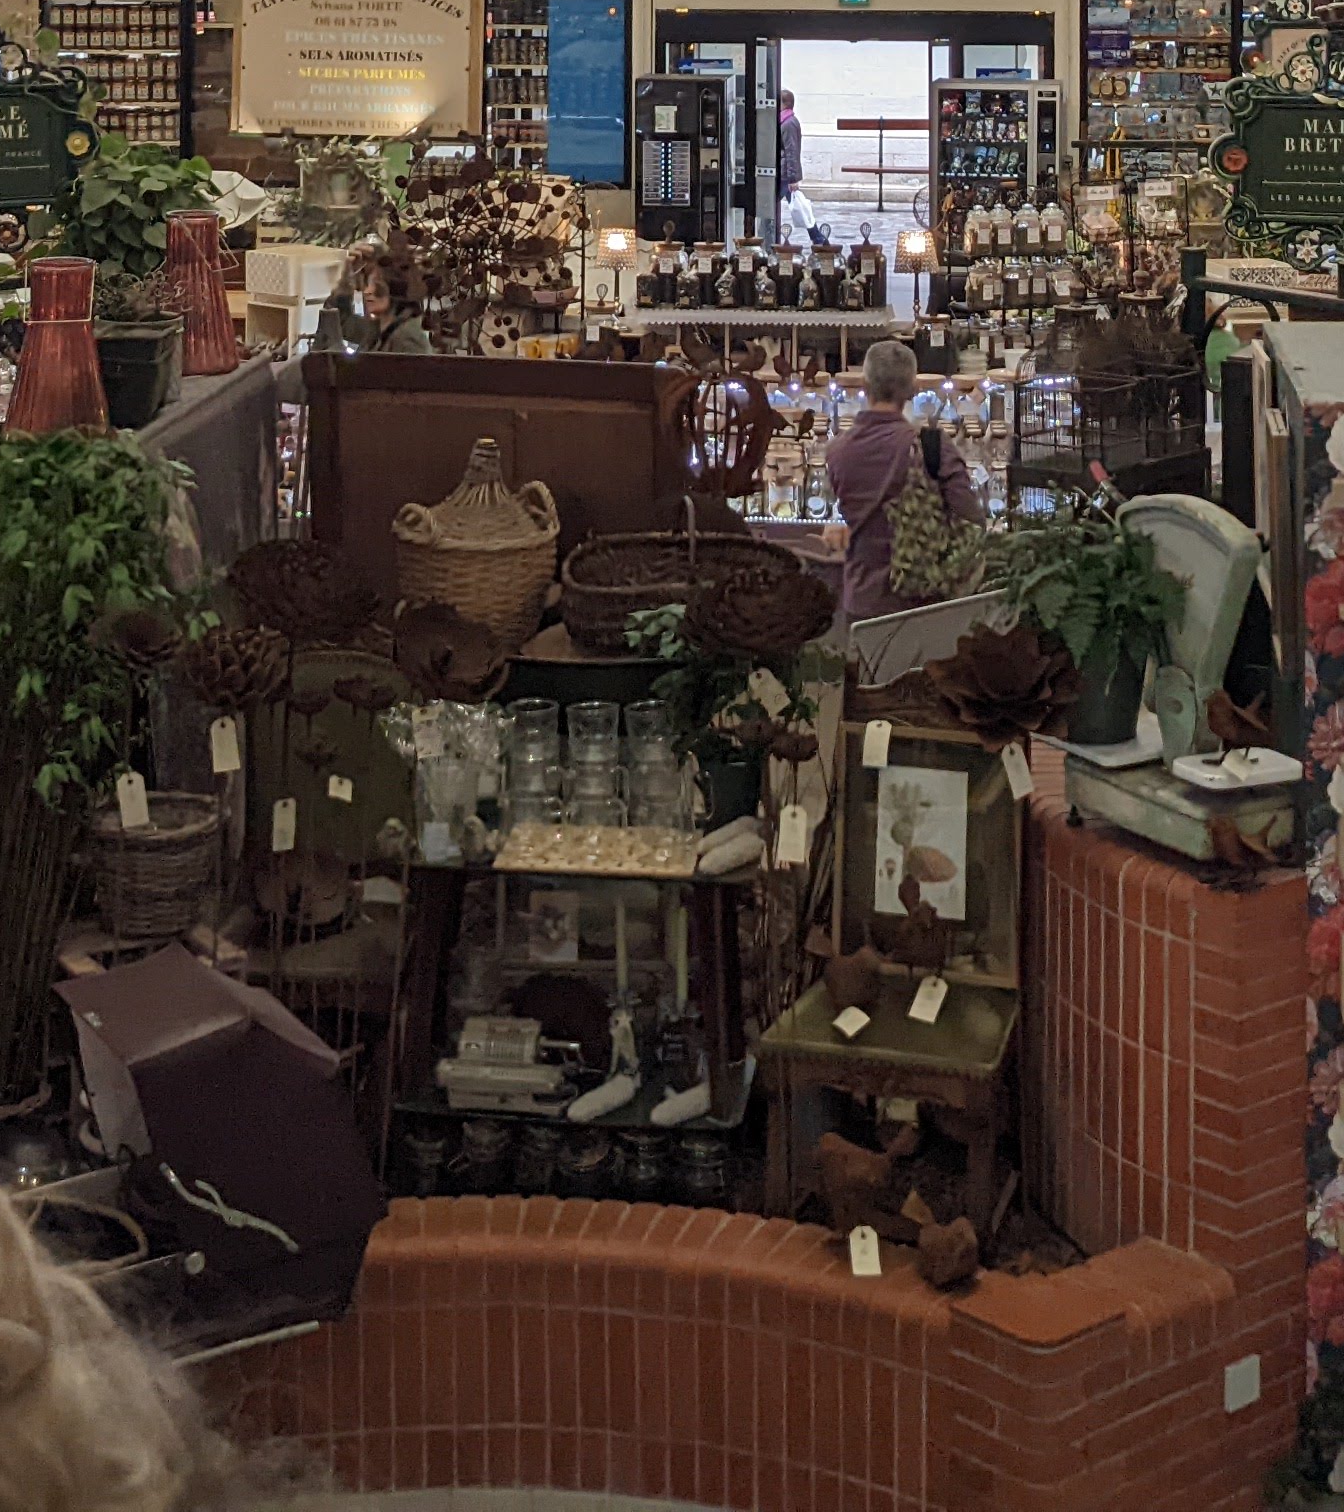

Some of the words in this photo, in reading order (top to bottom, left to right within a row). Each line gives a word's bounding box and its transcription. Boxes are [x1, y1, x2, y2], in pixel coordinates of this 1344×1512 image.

[299, 49, 333, 61] SELS
[336, 49, 424, 62] AROMATISÉS
[299, 66, 350, 79] SUCRES
[1285, 164, 1335, 172] ARTISAN
[1298, 194, 1343, 203] HALLES
